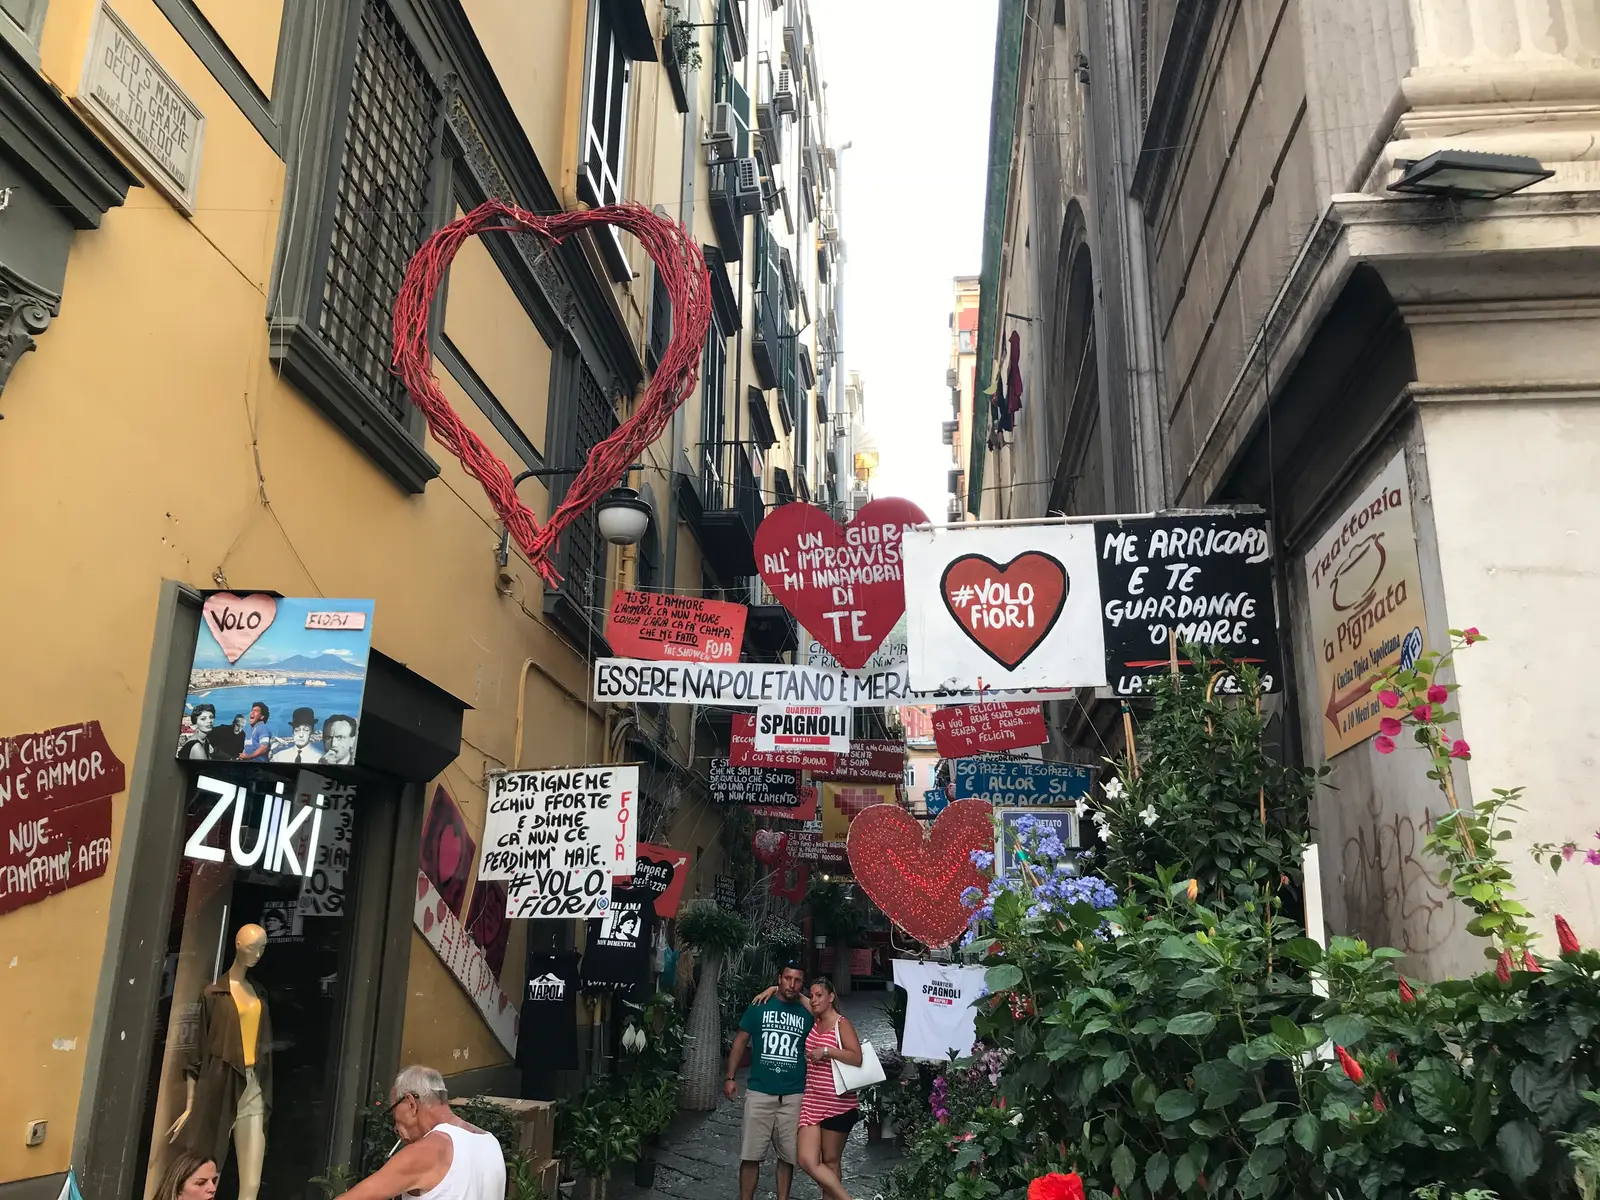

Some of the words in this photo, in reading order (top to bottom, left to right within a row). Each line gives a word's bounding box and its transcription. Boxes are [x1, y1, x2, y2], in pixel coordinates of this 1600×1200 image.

[114, 32, 140, 76] VICO
[143, 67, 153, 89] S
[155, 80, 187, 130] MARIA
[105, 46, 146, 105] DELLE
[149, 96, 189, 153] GRAZIE
[97, 84, 134, 131] QUARTIERE
[136, 128, 185, 183] MONTECALVARIO
[128, 93, 173, 158] TOLEDO
[798, 531, 823, 550] UN
[1312, 486, 1402, 589] Trattoria
[1103, 532, 1139, 565] ME
[784, 572, 804, 591] MI
[1128, 566, 1149, 595] E
[1164, 563, 1202, 592] TE
[639, 593, 651, 605] SI
[656, 595, 705, 611] L'AMMORE
[832, 585, 854, 606] DI
[951, 578, 1035, 608] #VOLO
[671, 610, 690, 620] NUN
[693, 612, 721, 626] MORE
[1105, 591, 1257, 627] GUARDANNE
[1337, 578, 1407, 653] Pignata
[211, 606, 262, 633] VOLO
[823, 610, 872, 643] TE
[639, 628, 657, 638] CHE
[705, 640, 733, 659] FOJA
[1336, 668, 1353, 690] Cucina
[1353, 657, 1369, 680] Tipica
[1369, 634, 1400, 668] Napoletana
[597, 665, 679, 697] ESSERE
[682, 668, 834, 701] NAPOLETANO
[785, 706, 822, 715] QUARTIERI
[955, 708, 963, 717] A
[760, 714, 846, 736] SPAGNOLI
[935, 721, 945, 731] SI
[970, 712, 990, 724] BENE
[991, 710, 1013, 721] SENZA
[951, 726, 977, 737] SENZA
[982, 722, 991, 731] CE
[966, 738, 973, 746] A
[752, 753, 763, 761] CU
[765, 753, 773, 761] TE
[786, 755, 800, 763] STO
[737, 767, 751, 775] SAI
[752, 767, 763, 775] TU
[979, 762, 1007, 775] PAZZ
[495, 771, 613, 798] ASTRIGNEME
[720, 775, 747, 783] QUELLO
[748, 775, 763, 783] CHE
[765, 773, 796, 784] SENTO
[728, 783, 744, 791] UNA
[746, 783, 768, 792] FITTA
[965, 775, 976, 792] E
[989, 776, 1036, 792] ALLOR
[1048, 778, 1068, 794] SI
[544, 792, 612, 812] FFORTE
[713, 791, 724, 803] MA
[746, 792, 756, 803] ME
[758, 791, 797, 804] LAMENTO
[531, 811, 587, 830] DIMME
[528, 829, 559, 846] NUN
[564, 826, 590, 843] CE
[607, 940, 636, 948] DIMENTICA
[922, 984, 961, 999] SPAGNOLI
[931, 980, 953, 988] QUARTIERI
[762, 1010, 804, 1030] HELSINKI
